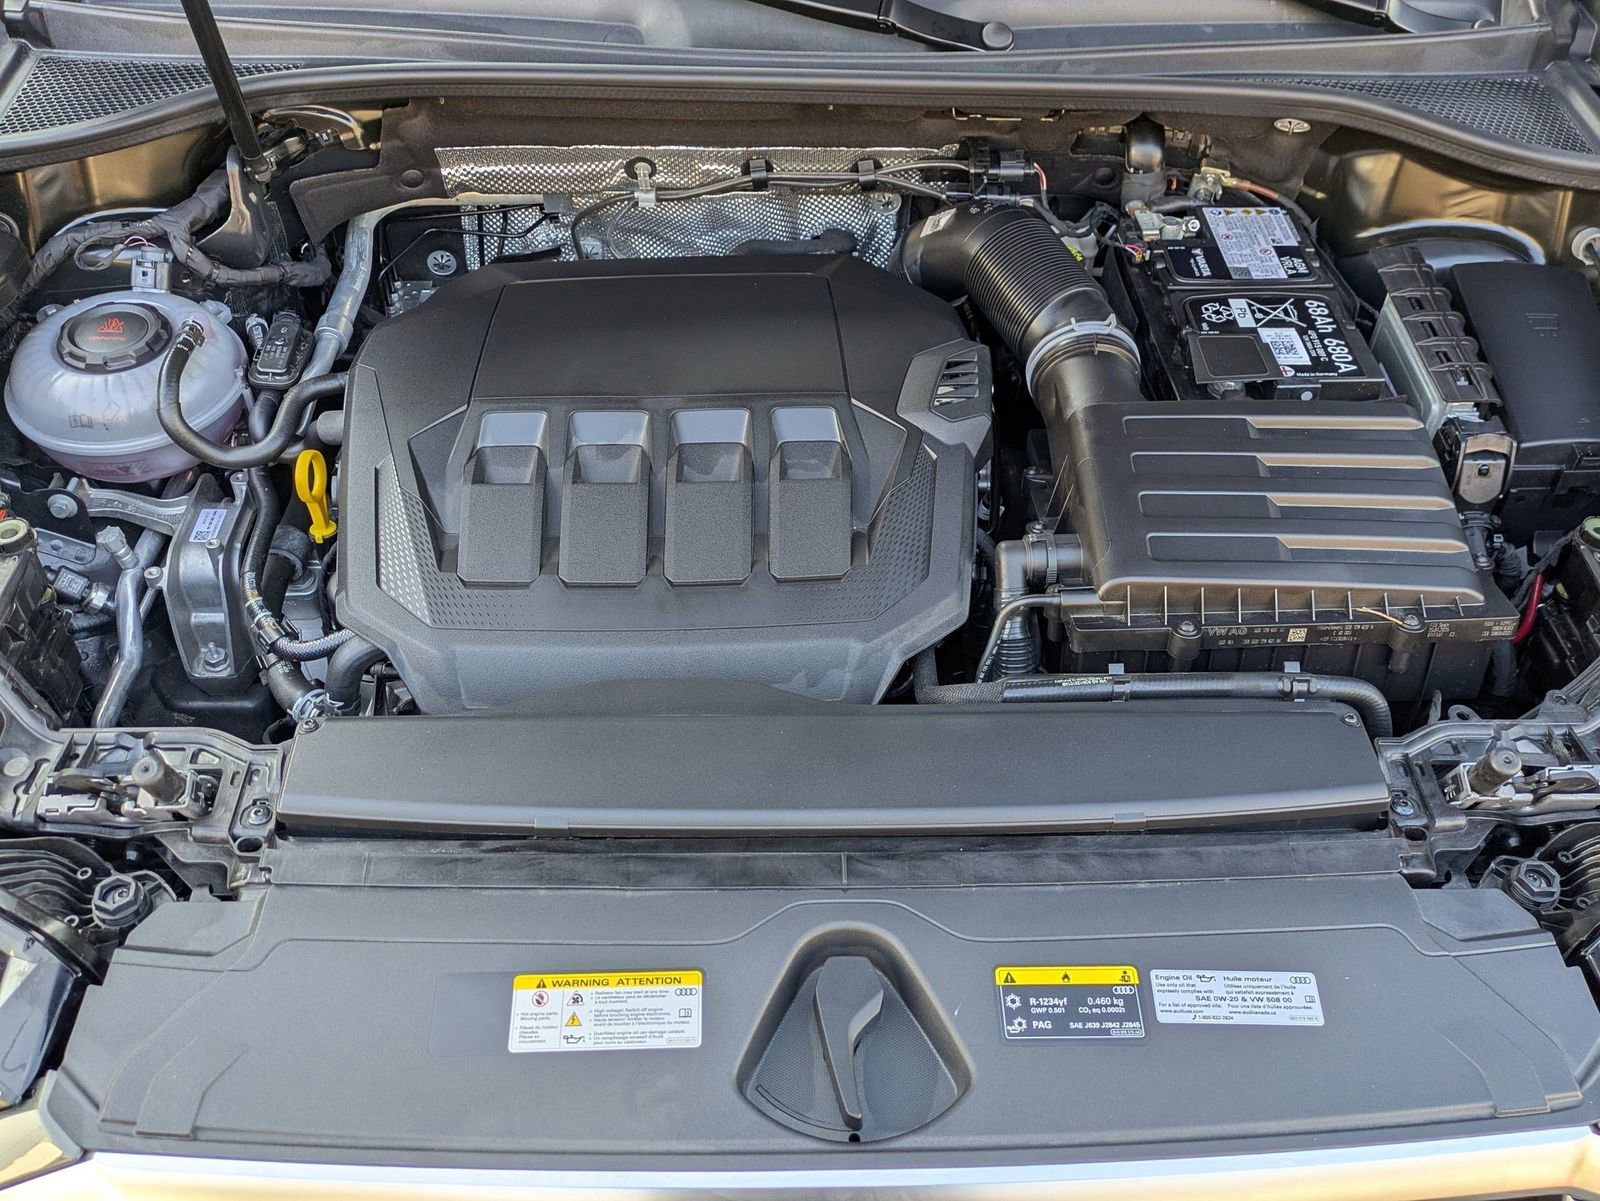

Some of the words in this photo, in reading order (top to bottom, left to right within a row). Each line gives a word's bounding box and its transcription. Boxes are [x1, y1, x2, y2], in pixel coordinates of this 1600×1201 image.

[1280, 256, 1297, 274] VRLA
[1291, 257, 1309, 273] AGM
[1236, 307, 1247, 318] Pb
[1304, 300, 1336, 333] 68Ah
[1324, 338, 1358, 373] 680A
[1208, 627, 1228, 636] VW
[1229, 627, 1248, 635] AG
[552, 979, 609, 988] WARNING
[616, 977, 682, 986] ATTENTION
[1030, 997, 1067, 1006] R-1234yf
[1113, 997, 1124, 1006] kg
